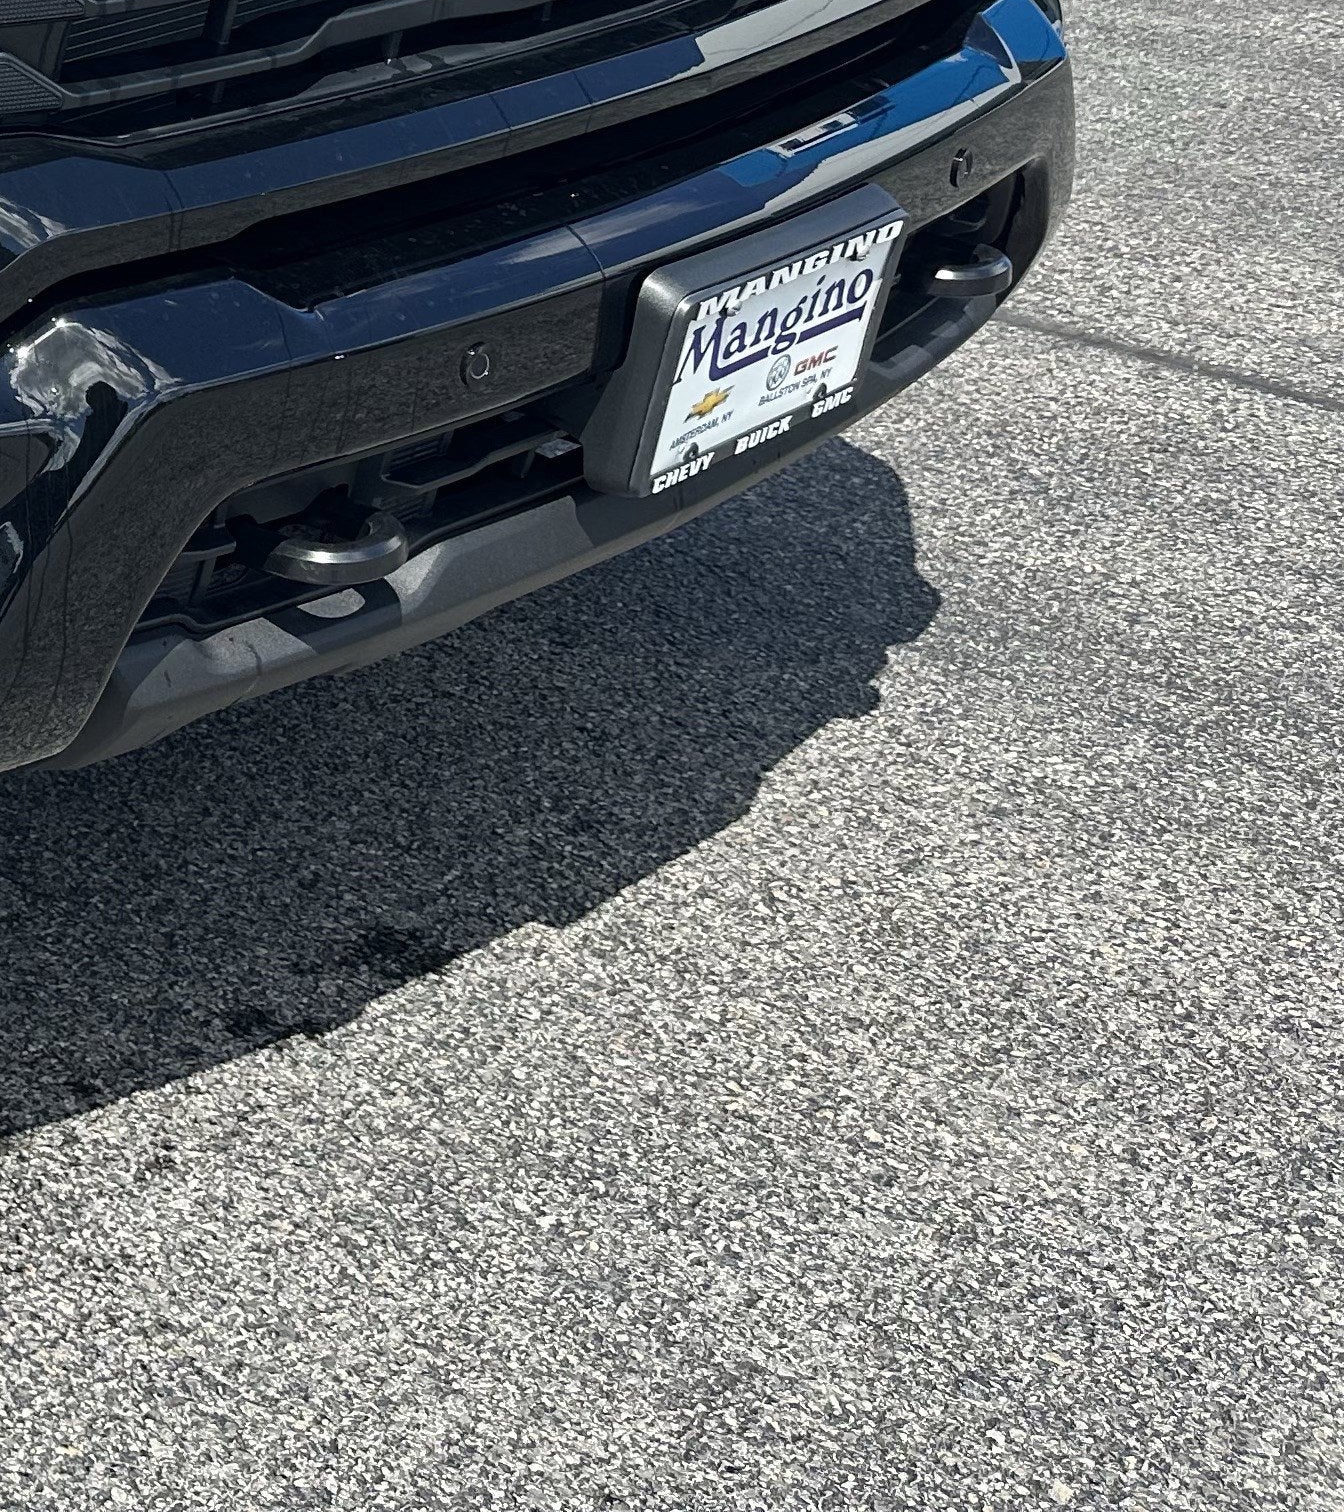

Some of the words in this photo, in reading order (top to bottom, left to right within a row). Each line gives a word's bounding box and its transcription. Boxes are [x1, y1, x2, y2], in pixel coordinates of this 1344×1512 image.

[696, 220, 905, 321] MANGINO
[675, 268, 874, 381] Mangino
[793, 345, 839, 377] GMC
[652, 452, 715, 494] CHEVY
[734, 416, 793, 455] BUICK
[811, 386, 854, 419] GMC
